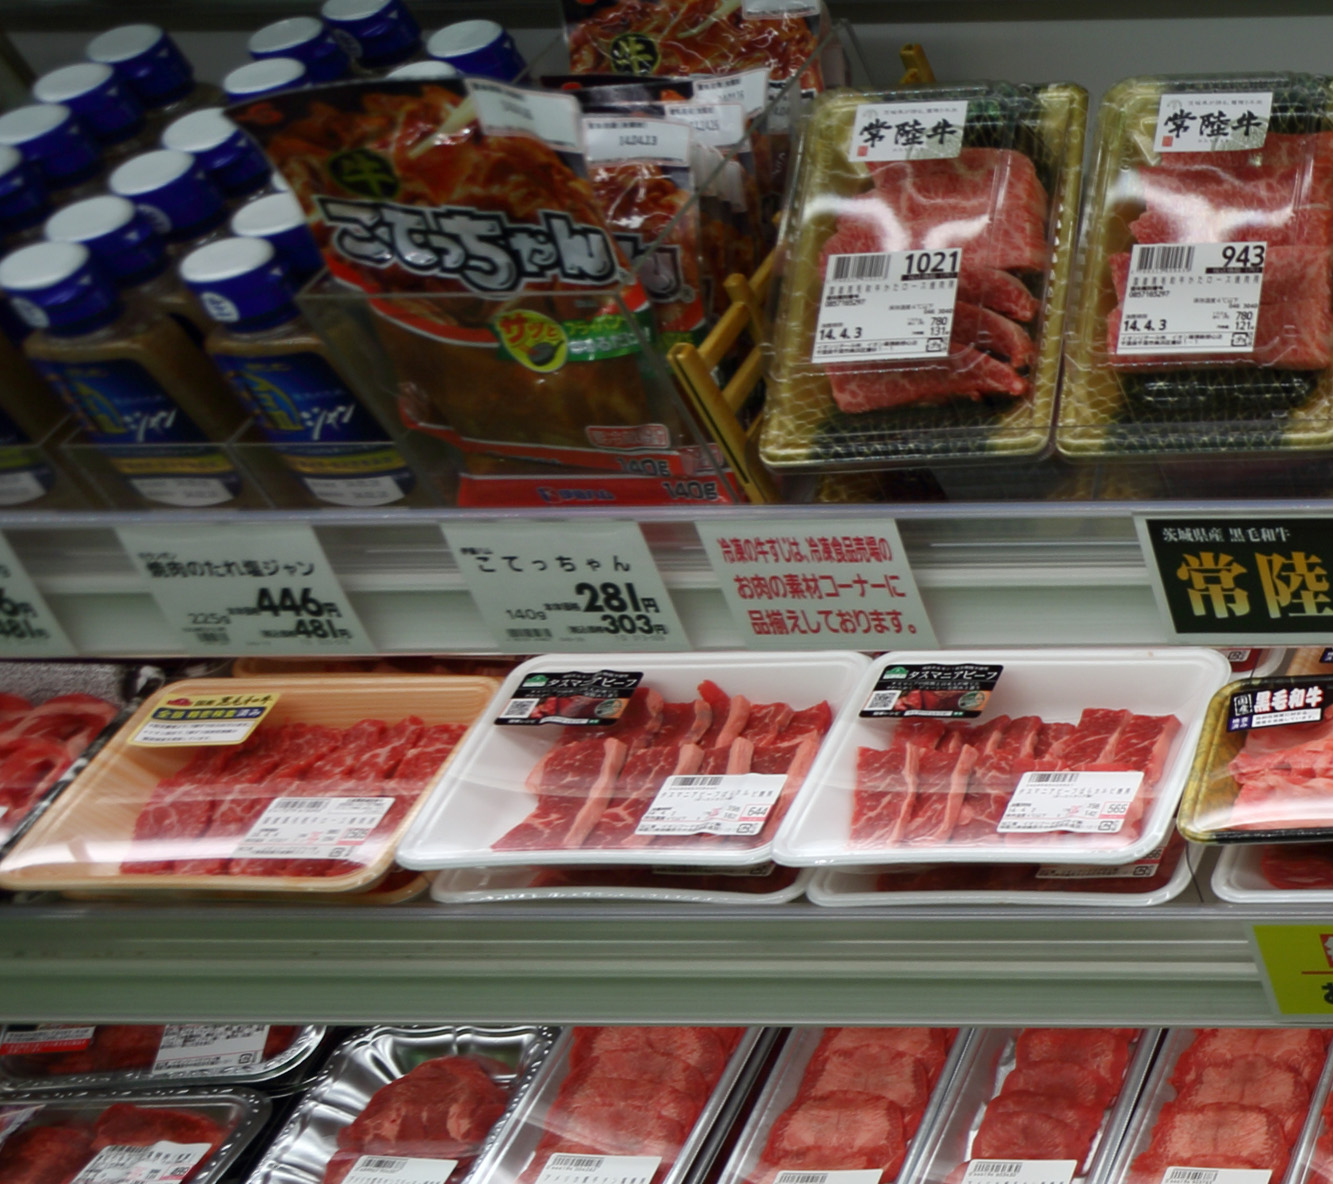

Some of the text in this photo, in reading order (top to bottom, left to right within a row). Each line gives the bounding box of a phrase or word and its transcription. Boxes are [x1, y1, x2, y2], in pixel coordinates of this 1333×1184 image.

[860, 119, 957, 148] 常陸牛
[1164, 110, 1262, 138] 常陸牛
[905, 251, 959, 274] 1021
[1222, 245, 1265, 268] 943
[663, 482, 718, 498] 140g
[1162, 527, 1291, 543] 茨城県産 黒毛和牛
[717, 536, 893, 563] 冷凍の牛すじは、冷凍食品売場の
[476, 554, 632, 574] こてっちゃん
[577, 583, 659, 613] 281円
[733, 574, 906, 600] お肉の素材コーナーに
[256, 586, 341, 617] 446円
[506, 608, 547, 622] 140g
[601, 615, 666, 635] 303円
[747, 609, 917, 635] 品揃えしております。
[295, 618, 352, 638] 481円
[908, 670, 997, 680] タスマニアビーフ
[1254, 686, 1323, 713] 黒毛和牛
